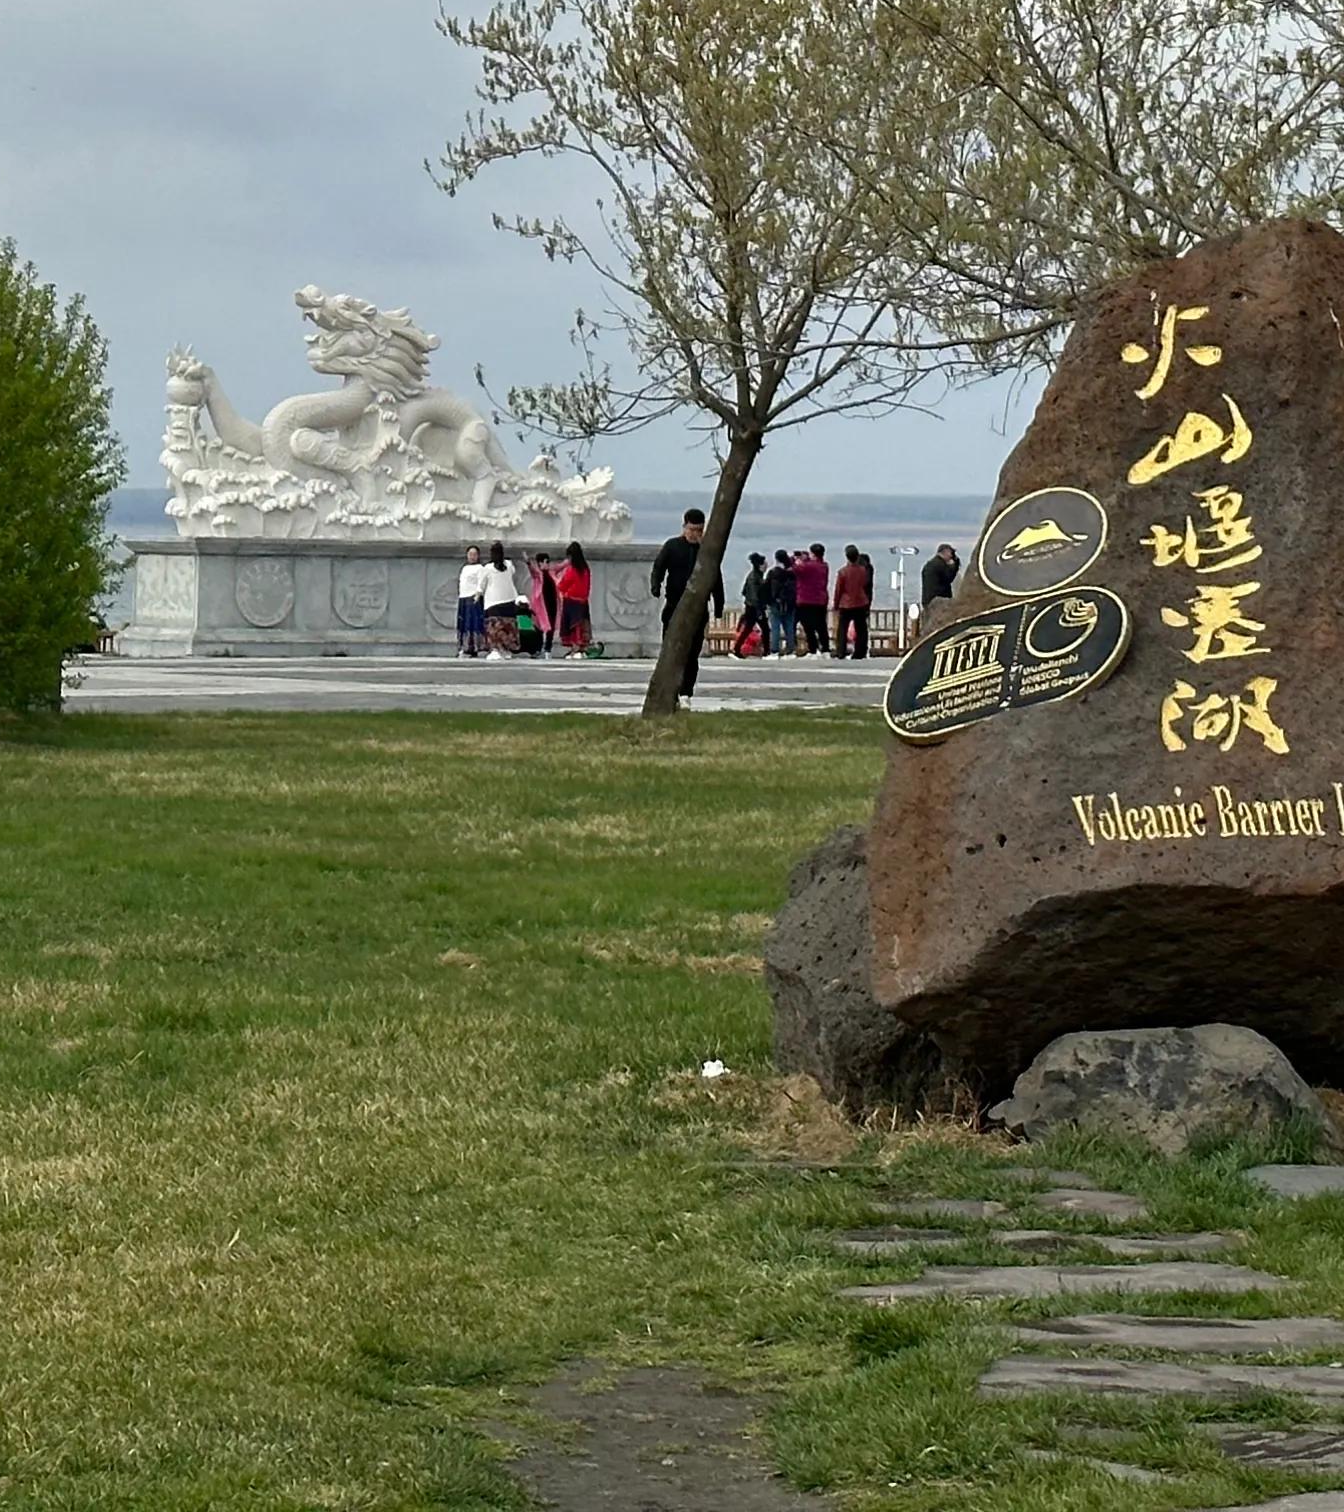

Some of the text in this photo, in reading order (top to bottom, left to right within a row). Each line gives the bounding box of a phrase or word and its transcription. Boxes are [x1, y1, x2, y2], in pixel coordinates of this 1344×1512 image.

[1120, 304, 1290, 755] 火山堰塞湖
[932, 635, 1000, 679] UNESCO
[1071, 785, 1207, 846] Volcanic
[1211, 784, 1327, 838] Barrier
